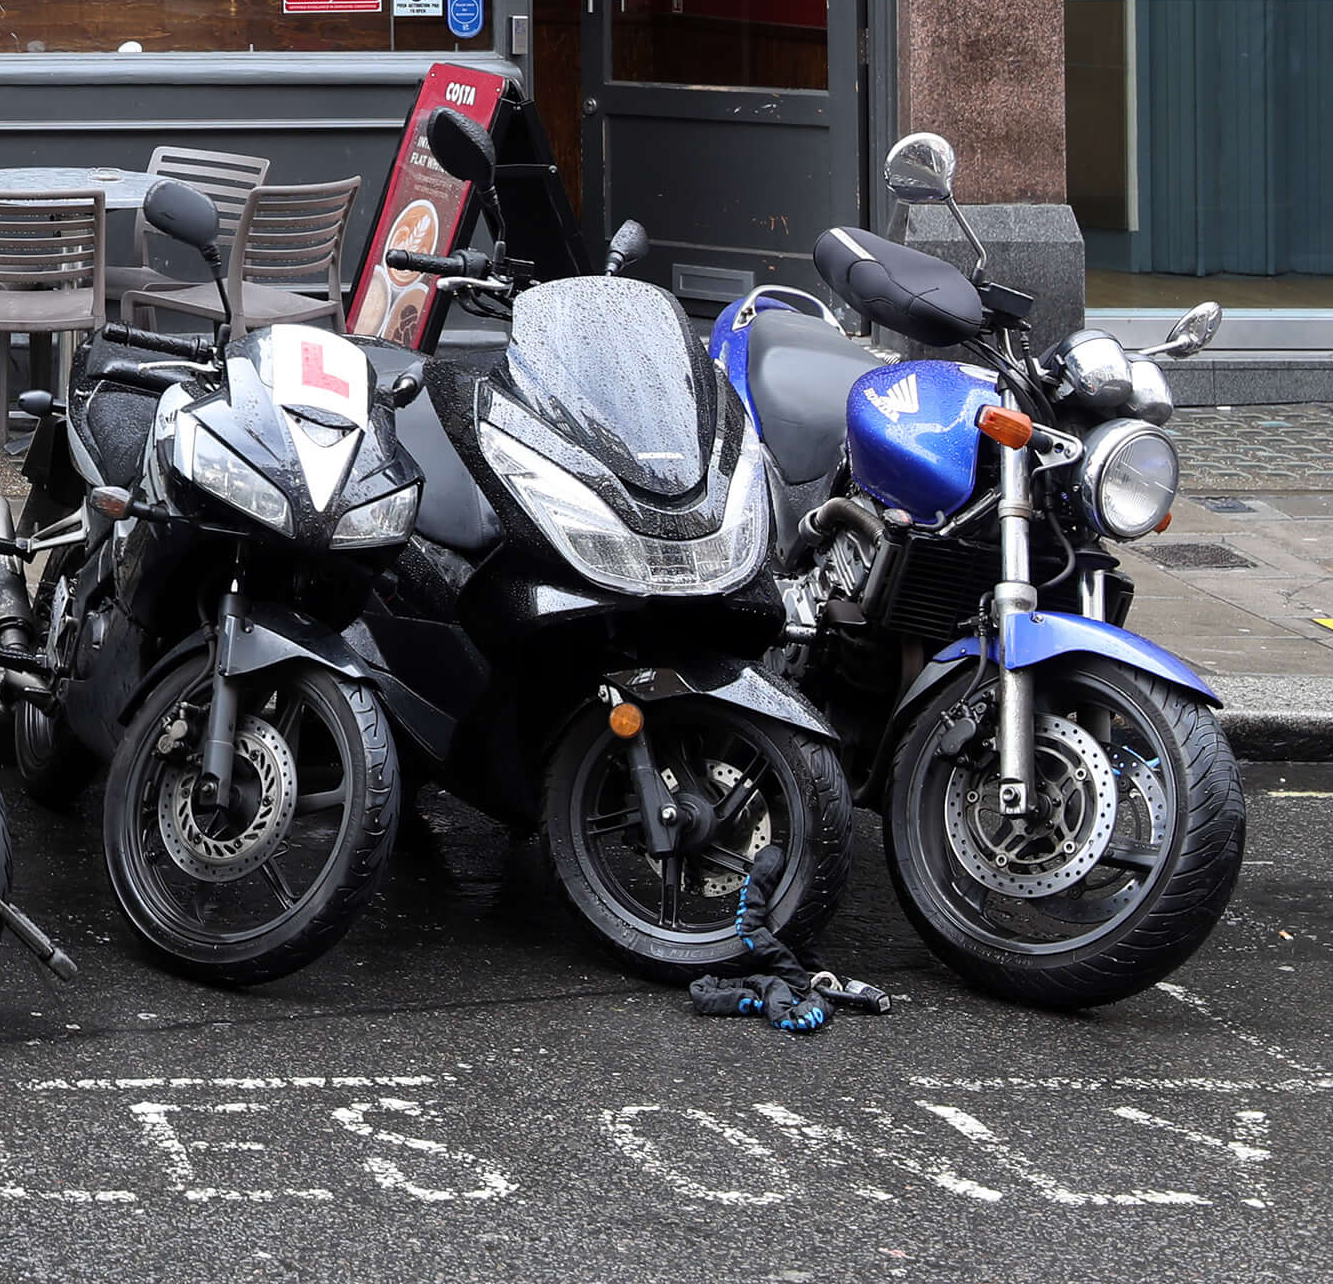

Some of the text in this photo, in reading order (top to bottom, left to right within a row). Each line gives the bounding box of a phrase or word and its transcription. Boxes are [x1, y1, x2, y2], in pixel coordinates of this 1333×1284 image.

[445, 82, 476, 106] COSTA
[409, 152, 428, 167] FLAT
[301, 341, 350, 399] L
[863, 387, 901, 424] HONDA
